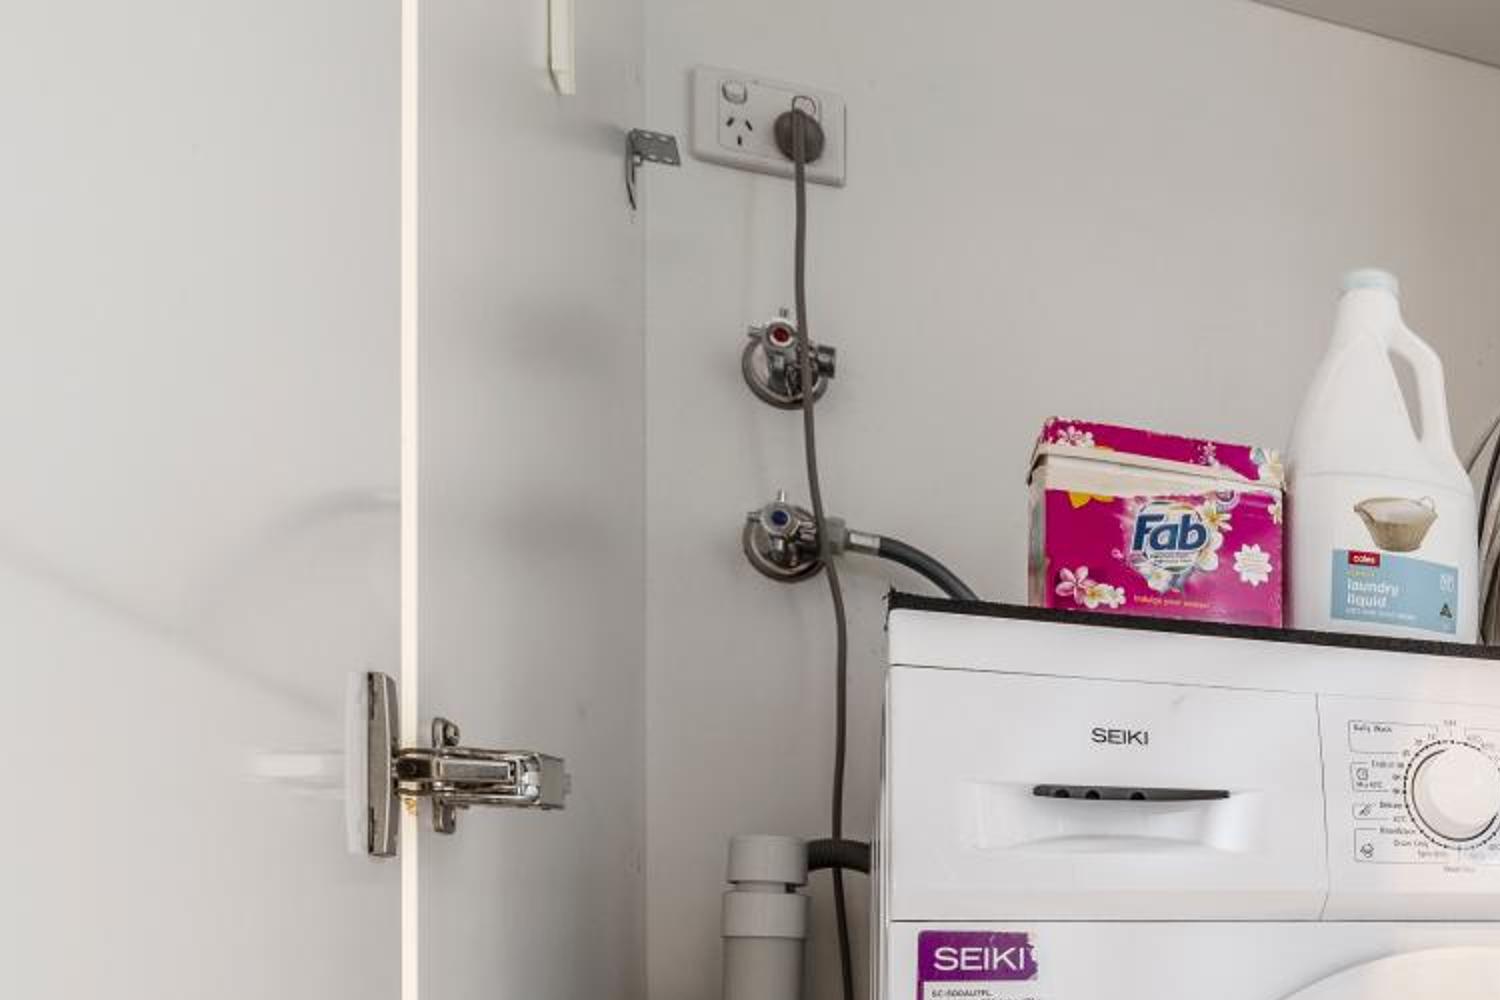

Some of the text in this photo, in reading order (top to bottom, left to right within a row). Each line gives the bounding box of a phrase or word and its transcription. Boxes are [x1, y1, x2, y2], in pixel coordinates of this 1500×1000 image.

[1133, 513, 1207, 551] Fab
[1353, 553, 1376, 565] coles
[1346, 578, 1400, 597] laundry
[1346, 592, 1387, 608] liquid
[1091, 727, 1149, 745] SEIKI
[933, 946, 1025, 971] SEIKI
